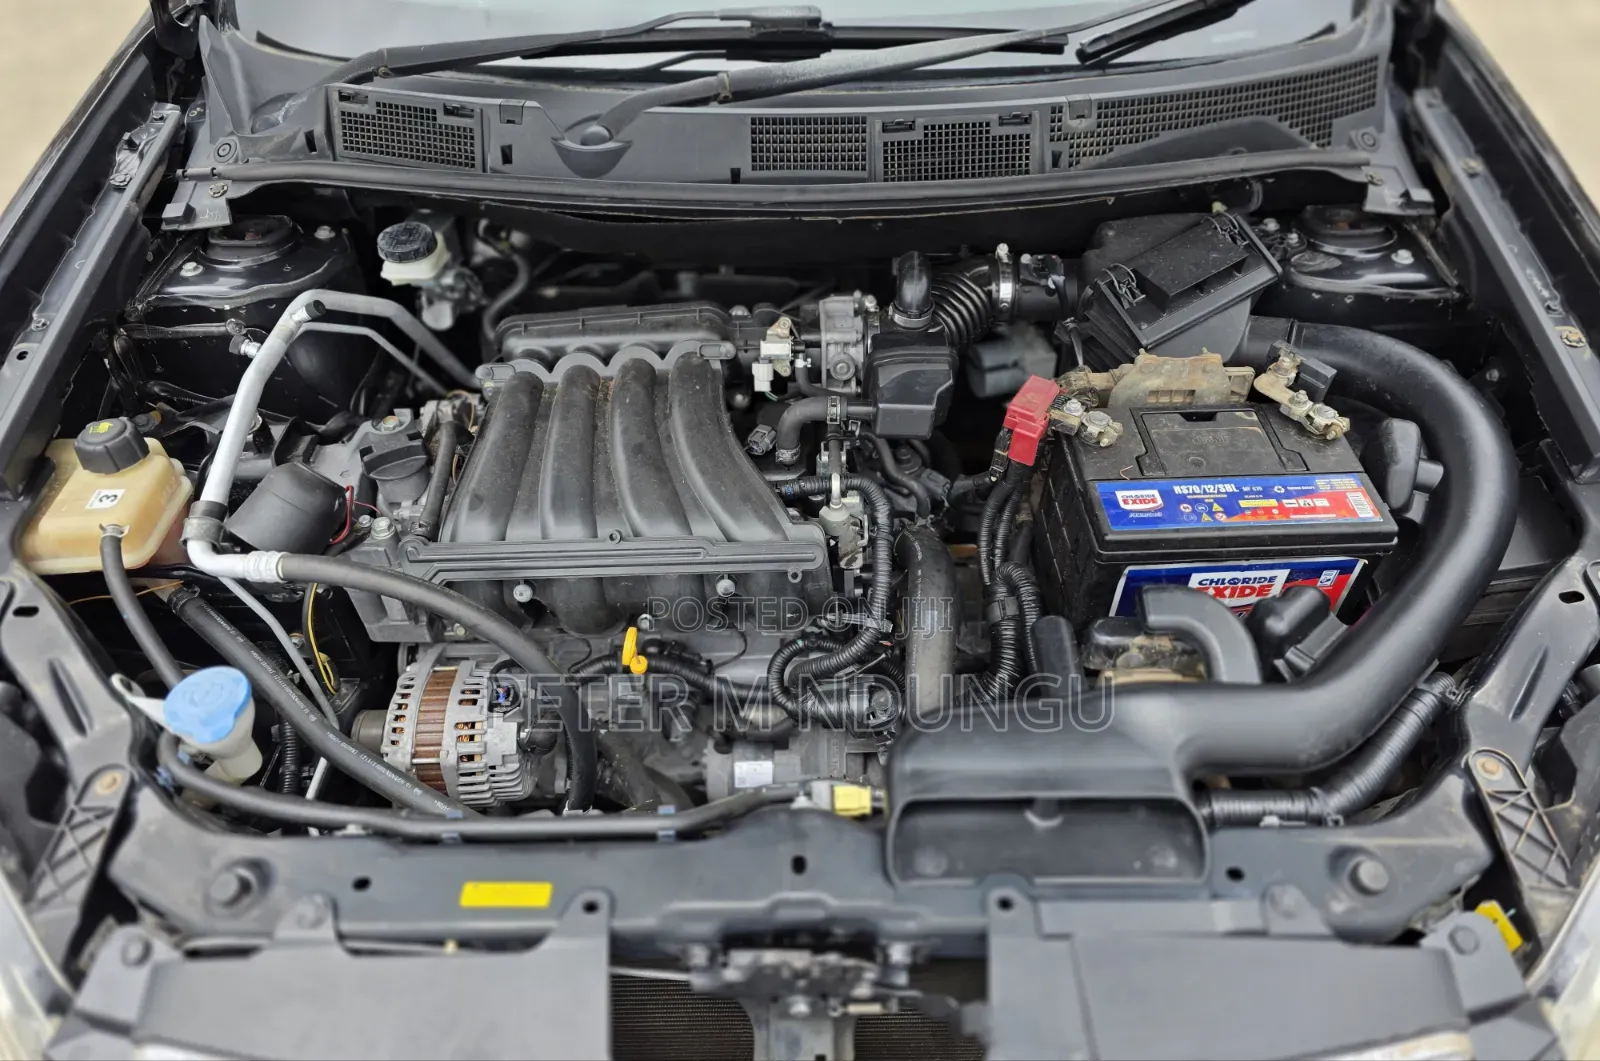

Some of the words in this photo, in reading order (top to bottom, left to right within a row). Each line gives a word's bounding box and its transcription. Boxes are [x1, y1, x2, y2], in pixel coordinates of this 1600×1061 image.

[99, 494, 118, 503] 3
[1122, 497, 1158, 506] EXIDE
[1197, 575, 1278, 587] CHLORIDE
